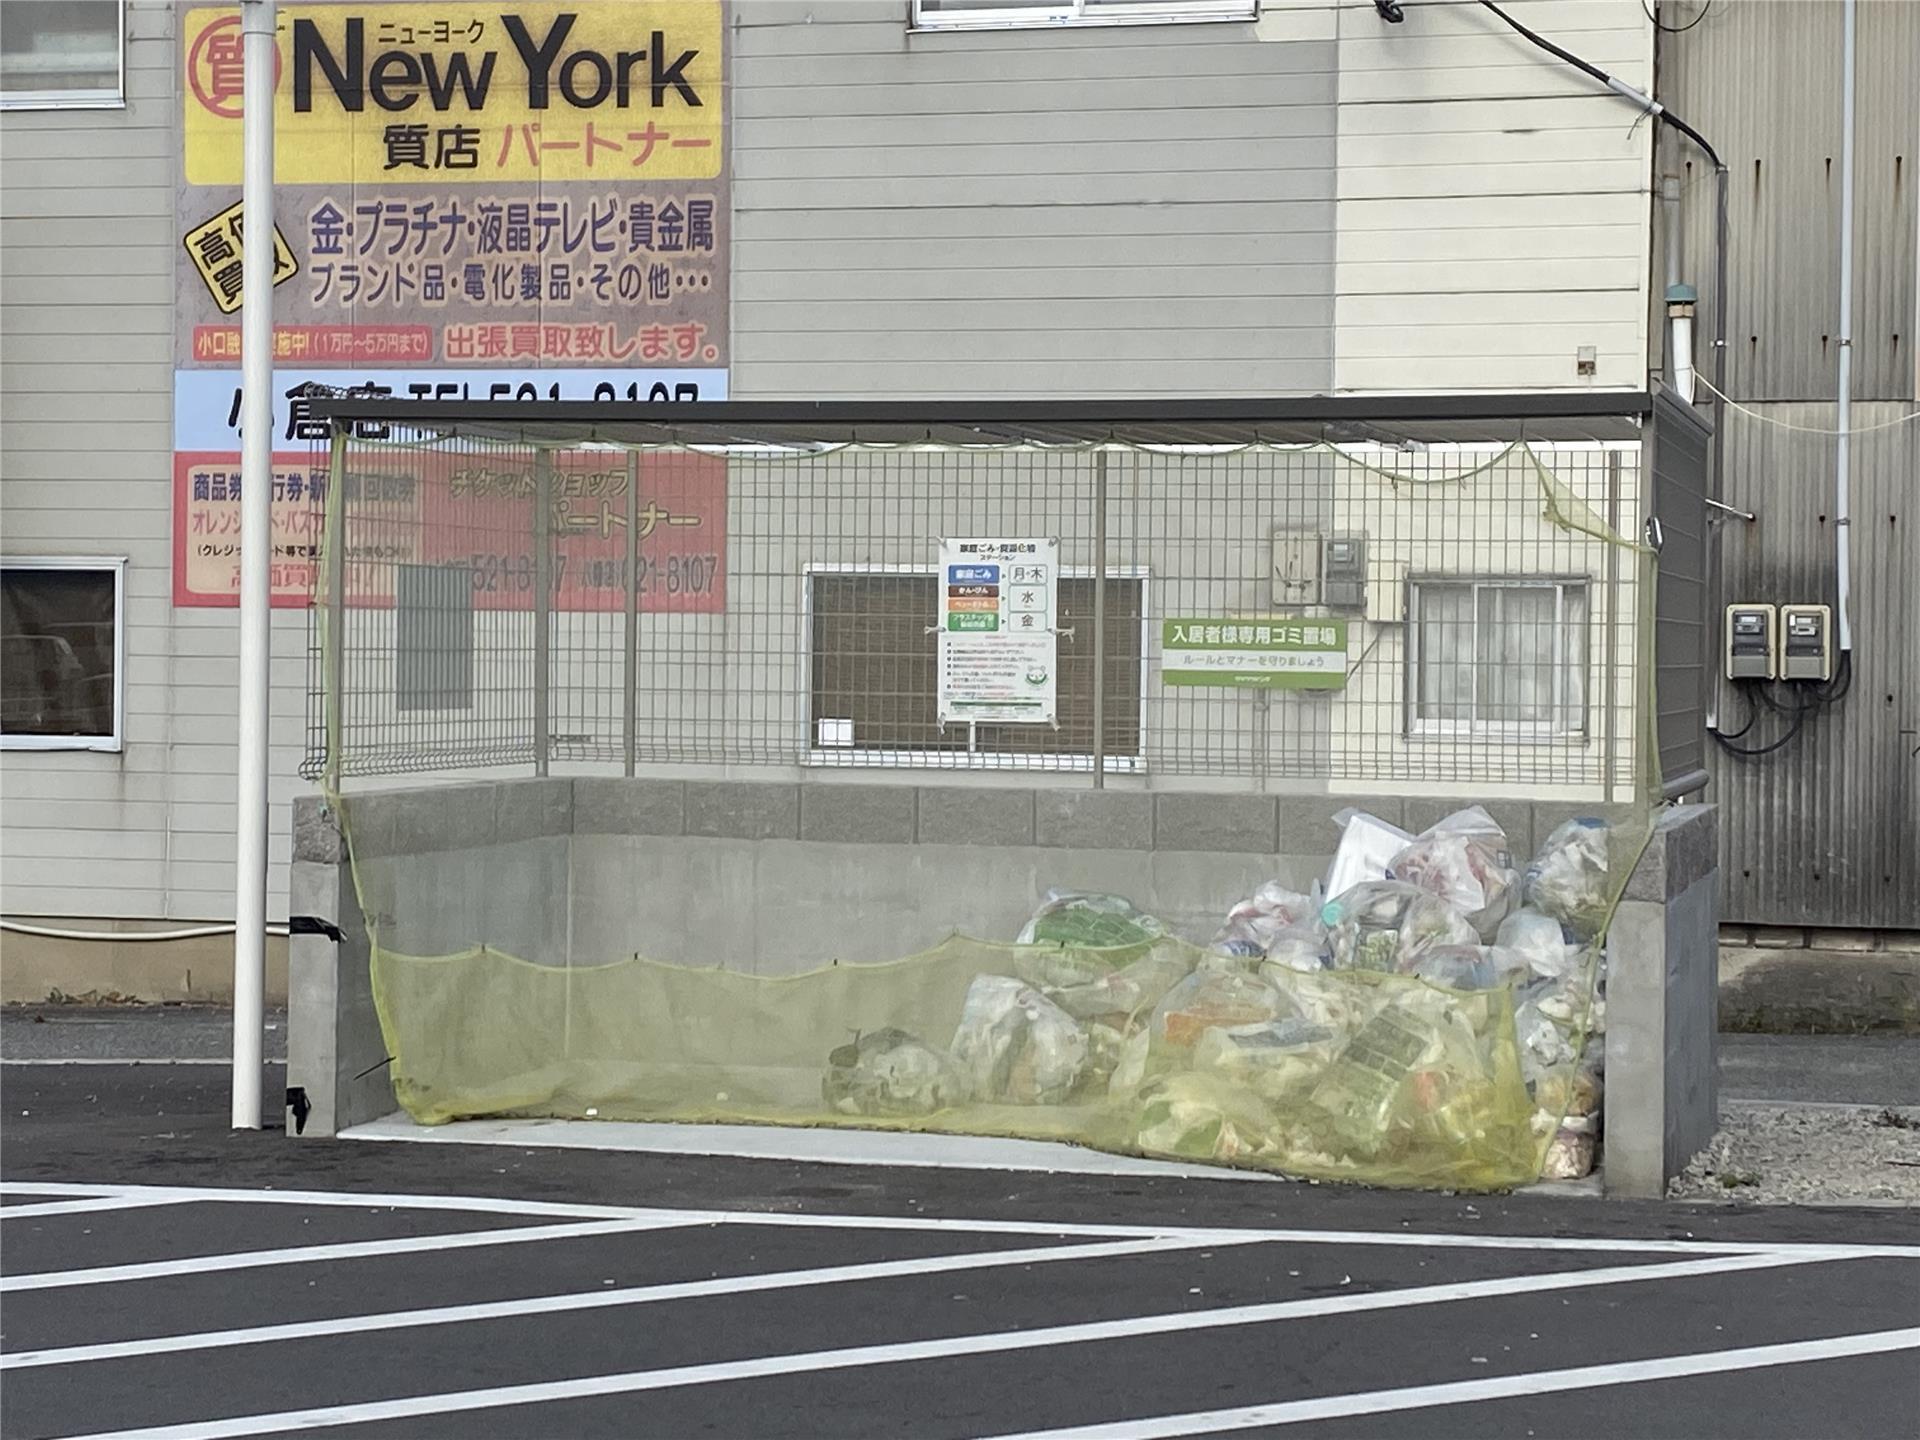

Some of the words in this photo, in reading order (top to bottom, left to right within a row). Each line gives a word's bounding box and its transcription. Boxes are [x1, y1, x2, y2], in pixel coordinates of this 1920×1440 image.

[378, 20, 485, 45] ニューヨーク
[293, 16, 497, 113] New
[501, 12, 704, 111] York
[383, 124, 482, 170] 質店
[497, 121, 712, 168] パートナー
[446, 325, 717, 361] 出張買取致します。
[1021, 590, 1034, 604] 水
[1021, 614, 1034, 627] 金
[1183, 655, 1325, 667] ルールとマナーを守りましょう
